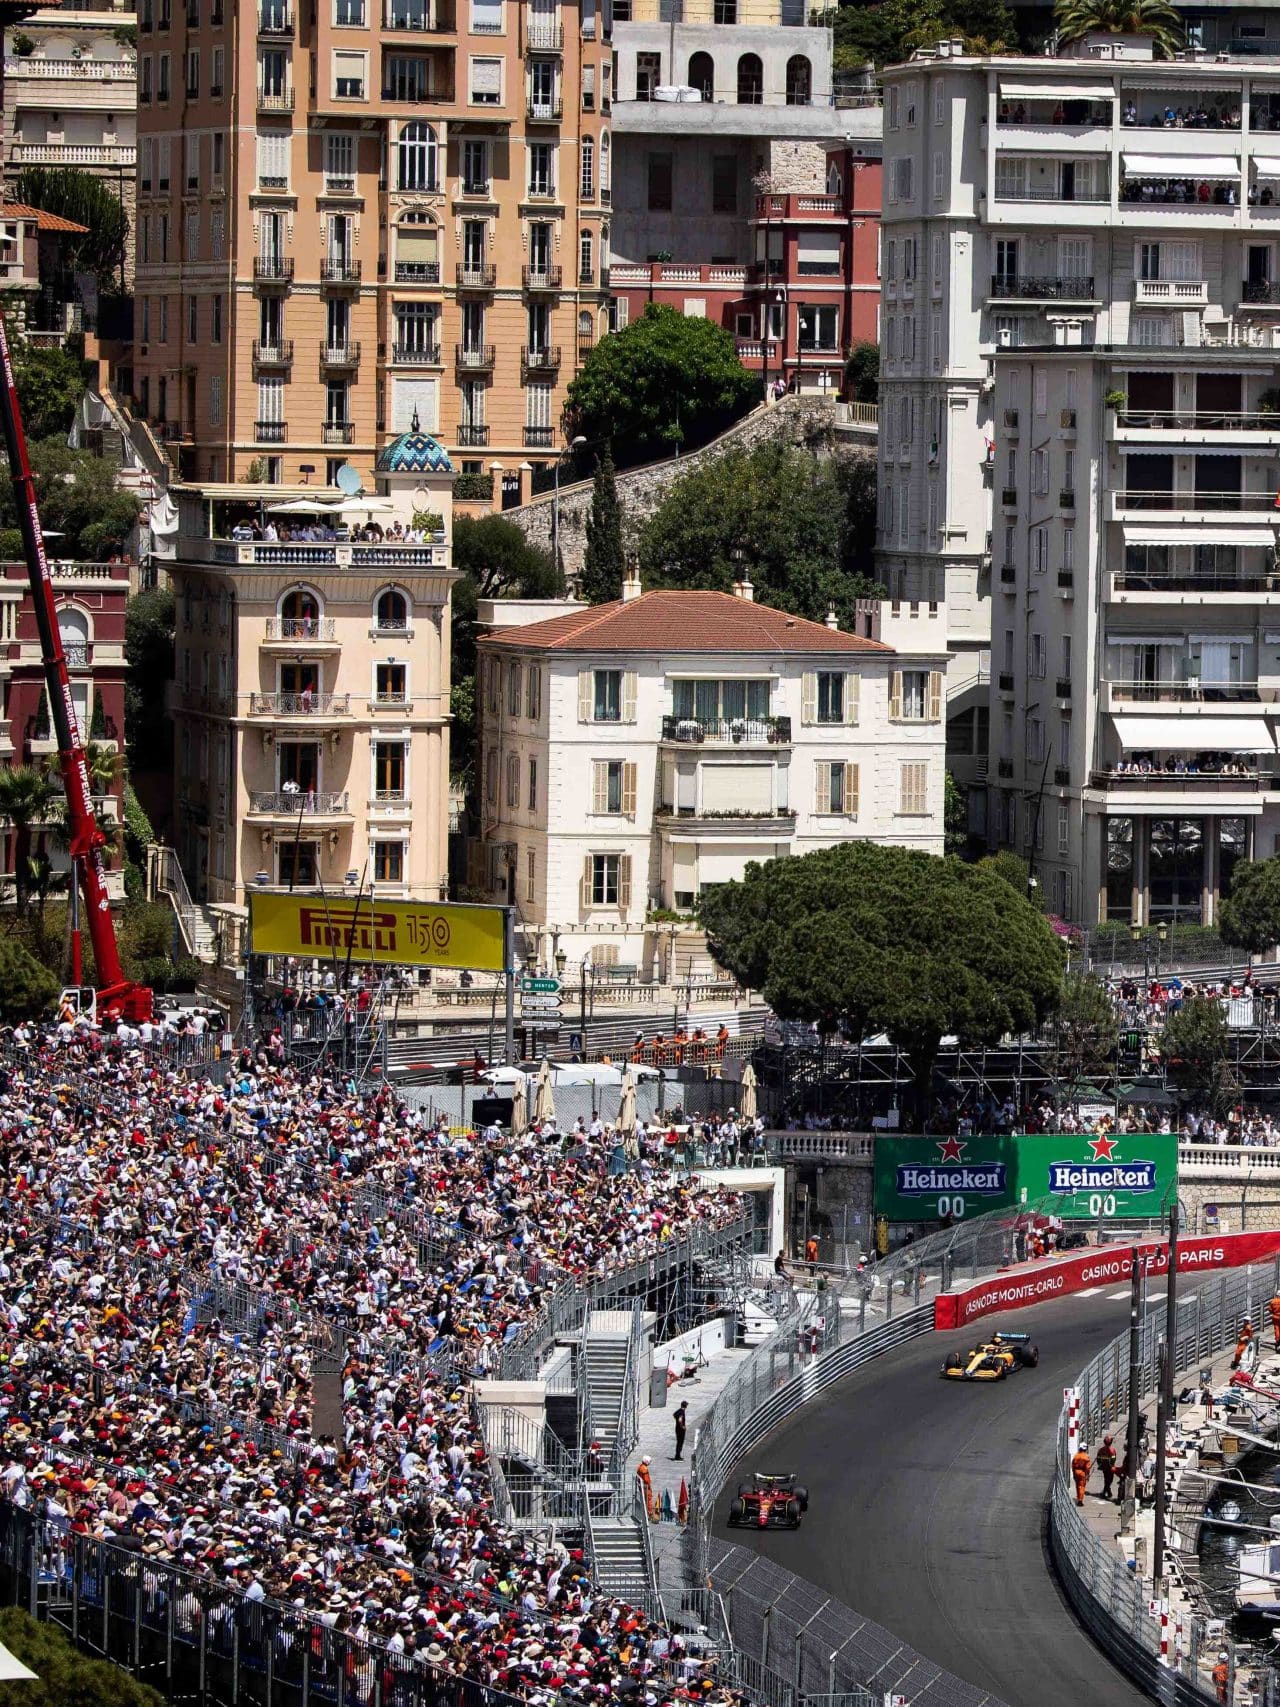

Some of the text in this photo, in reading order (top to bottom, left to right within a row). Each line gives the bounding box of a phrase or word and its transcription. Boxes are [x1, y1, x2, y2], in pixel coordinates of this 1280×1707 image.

[29, 502, 49, 580] IMPERIAL LEVAGE
[61, 683, 76, 731] IMPERIAL
[77, 759, 107, 890] IMPERIAL LEVAGE
[300, 907, 397, 951] PIRELLI
[406, 914, 451, 954] 150
[902, 1169, 1000, 1189] Heineken
[1055, 1167, 1149, 1187] Heineken
[1081, 1262, 1119, 1281] CASINO
[1180, 1248, 1224, 1264] PARIS
[965, 1275, 1064, 1315] CASINO DE MONTE-CARLO
